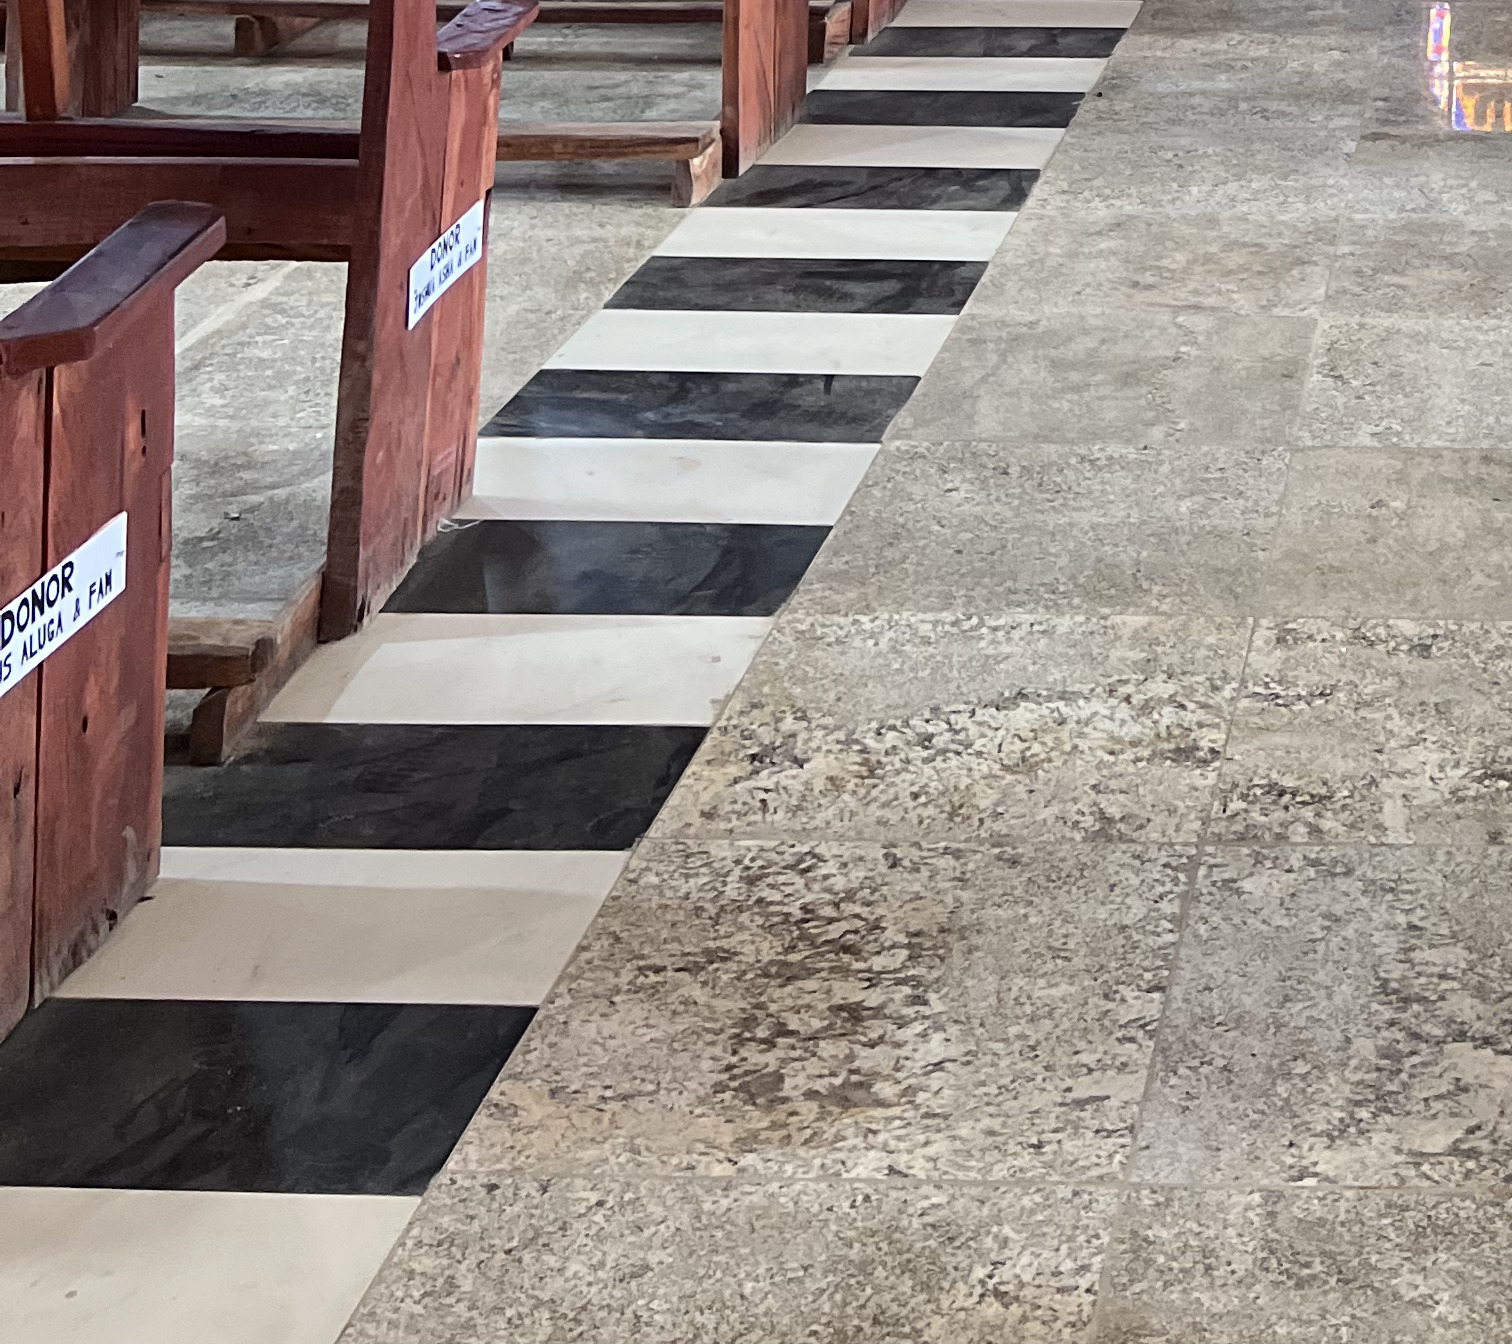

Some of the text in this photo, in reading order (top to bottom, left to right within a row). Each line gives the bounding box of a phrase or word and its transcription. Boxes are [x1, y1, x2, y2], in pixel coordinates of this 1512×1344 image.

[430, 223, 461, 271] DONOR
[0, 561, 74, 650] DONOR
[20, 611, 63, 666] ALUGA
[72, 597, 81, 622] &
[88, 568, 113, 610] FAM
